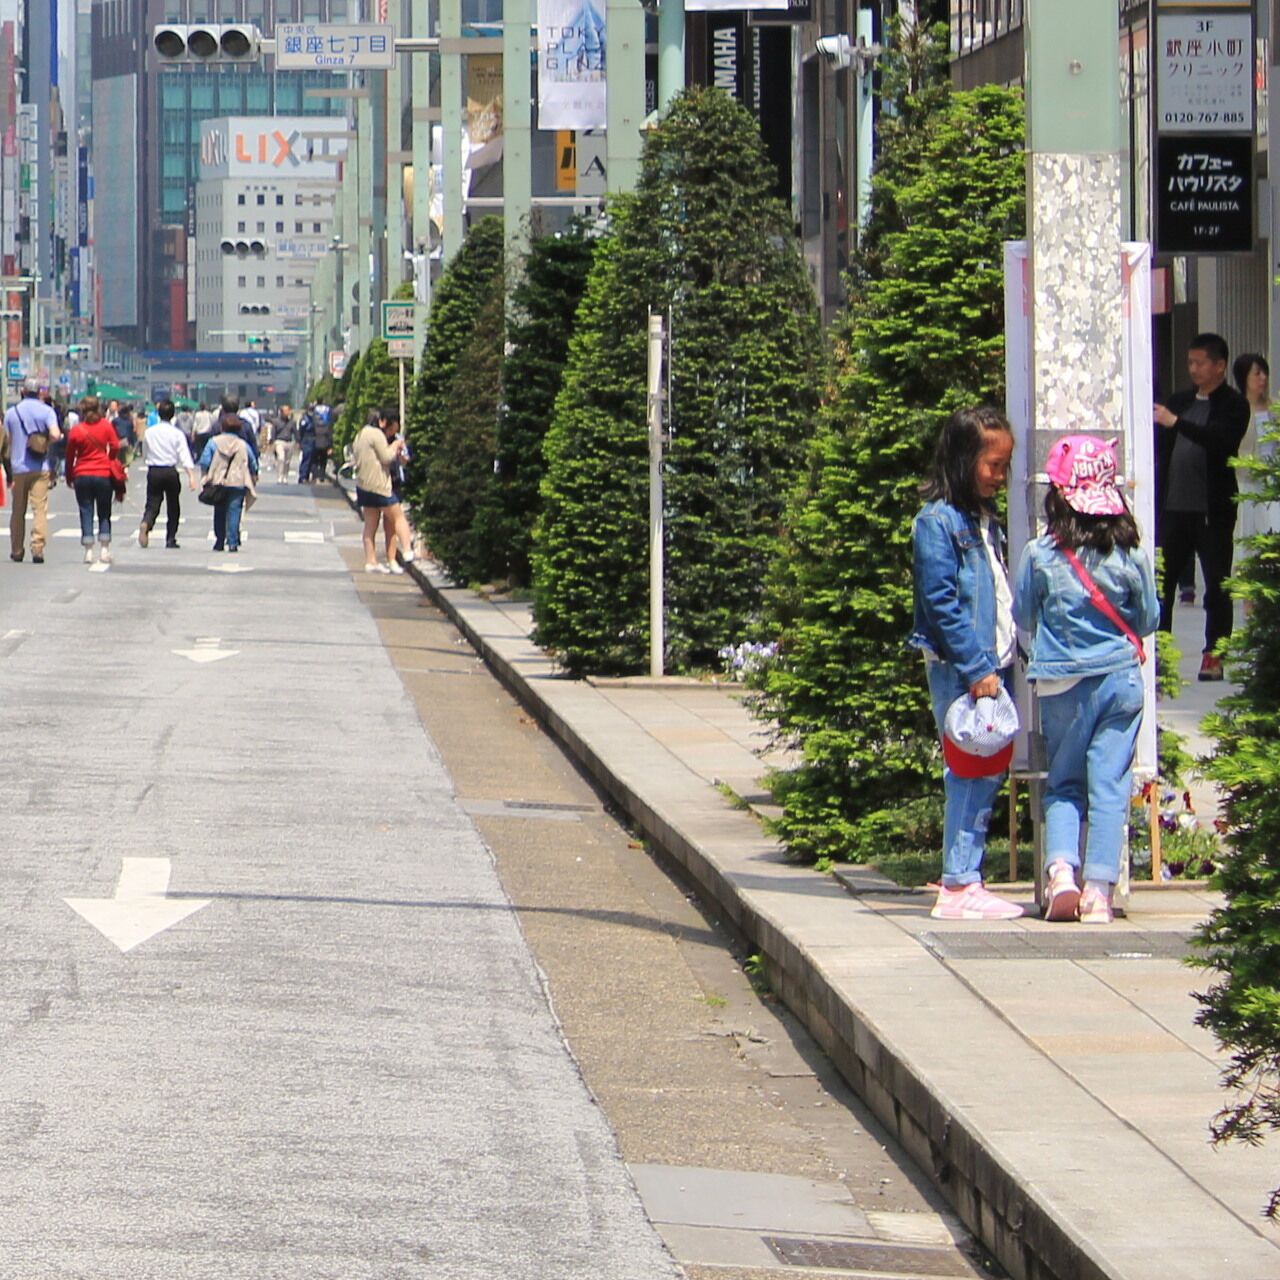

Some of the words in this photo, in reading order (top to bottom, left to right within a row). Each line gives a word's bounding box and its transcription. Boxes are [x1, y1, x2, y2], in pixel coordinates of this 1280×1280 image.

[1196, 20, 1215, 33] 3F
[284, 35, 386, 54] 銀座七丁目
[1166, 38, 1244, 57] 銀座小町
[315, 55, 345, 65] Ginza
[349, 55, 355, 65] 7
[1167, 62, 1245, 78] クリニック
[1164, 111, 1245, 124] 0120-767-885
[1197, 200, 1240, 211] PAULISTA
